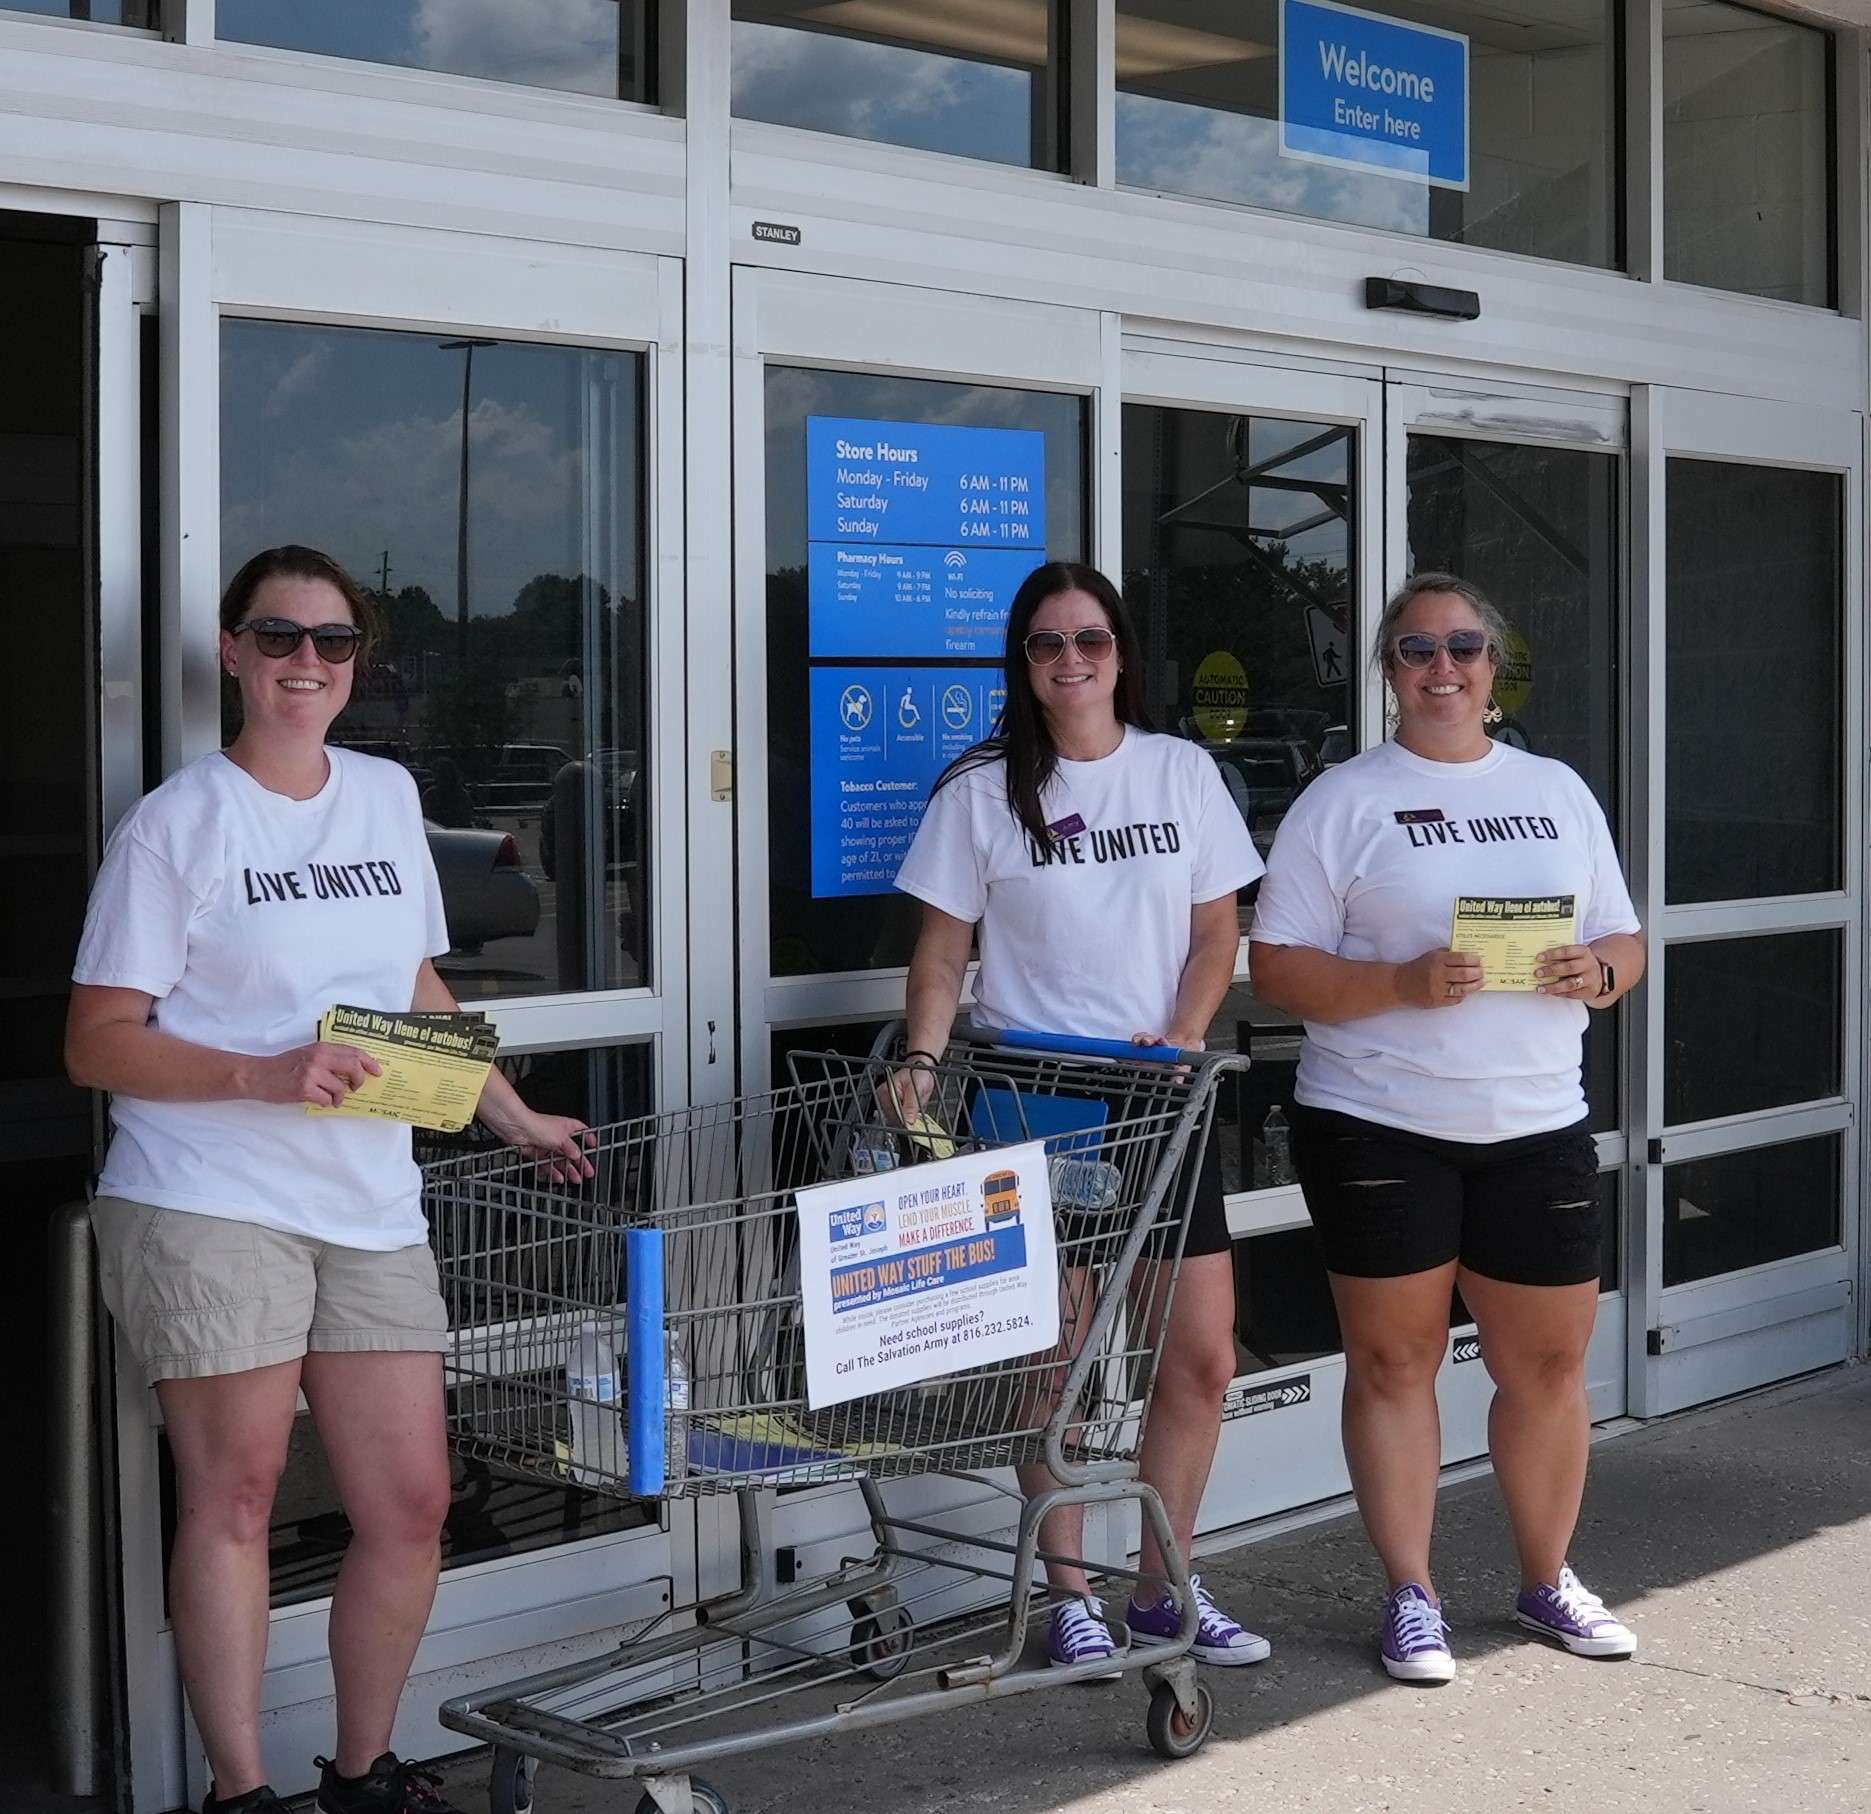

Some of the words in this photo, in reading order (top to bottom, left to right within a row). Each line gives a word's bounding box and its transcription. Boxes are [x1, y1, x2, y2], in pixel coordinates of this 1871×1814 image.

[1320, 40, 1434, 102] Welcome
[1335, 98, 1380, 130] Enter
[1385, 108, 1420, 140] here
[756, 226, 798, 241] STANLEY
[836, 440, 874, 460] Store
[876, 442, 918, 462] Hours
[837, 468, 882, 490] Monday
[894, 470, 928, 492] Friday
[960, 474, 968, 490] 6
[970, 475, 990, 490] AM
[1000, 476, 1008, 491] 11
[1010, 477, 1028, 492] PM
[837, 492, 888, 513] Saturday
[960, 498, 968, 514] 6
[970, 499, 990, 514] AM
[1000, 500, 1008, 514] 11
[1011, 500, 1029, 516] PM
[838, 517, 879, 538] Sunday
[960, 521, 968, 536] 6
[970, 522, 990, 536] AM
[1000, 523, 1008, 538] 11
[1011, 523, 1029, 538] PM
[837, 551, 878, 567] Pharmacy
[879, 553, 904, 565] Hours
[945, 588, 958, 599] No
[960, 588, 994, 602] soliciting
[945, 608, 970, 622] Kindly
[972, 609, 1000, 621] refrain
[945, 638, 976, 650] firearm
[1196, 688, 1246, 705] CAUTION
[840, 781, 874, 793] Tobacco
[840, 800, 887, 812] Customers
[890, 800, 907, 810] who
[841, 817, 854, 830] 40
[856, 817, 870, 828] will
[871, 818, 882, 828] be
[884, 816, 908, 828] asked
[910, 816, 919, 827] to
[1407, 821, 1465, 848] LIVE
[1468, 816, 1558, 844] UNITED
[841, 836, 876, 848] showing
[878, 836, 906, 847] proper
[1090, 822, 1180, 864] UNITED
[841, 854, 856, 867] age
[858, 851, 868, 862] of
[883, 853, 892, 861] or
[244, 867, 308, 906] LIVE
[308, 861, 402, 900] UNITED
[842, 868, 884, 884] permitted
[886, 868, 896, 880] to
[1460, 900, 1486, 912] United
[1488, 900, 1504, 916] Way
[336, 1008, 370, 1031] United
[372, 1015, 394, 1036] Way
[394, 1020, 418, 1038] llene
[420, 1026, 432, 1042] el
[430, 1030, 474, 1050] autobus!
[898, 1192, 918, 1210] OPEN
[920, 1188, 940, 1205] YOUR
[942, 1182, 968, 1200] HEART.
[830, 1208, 862, 1227] United
[898, 1212, 918, 1230] LEND
[920, 1207, 940, 1224] YOUR
[842, 1222, 863, 1237] Way
[898, 1230, 920, 1248] MAKE
[922, 1228, 928, 1241] A
[832, 1269, 876, 1298] UNITED
[878, 1260, 905, 1286] WAY
[908, 1254, 942, 1279] STUFF
[944, 1246, 966, 1271] THE
[968, 1238, 996, 1265] BUS!
[834, 1294, 872, 1312] presented
[872, 1290, 882, 1302] by
[882, 1282, 910, 1298] Mosaic
[910, 1279, 926, 1291] Life
[926, 1276, 944, 1287] Care
[880, 1332, 904, 1346] Need
[906, 1324, 938, 1341] school
[940, 1310, 985, 1333] supplies?
[836, 1360, 854, 1374] Call
[857, 1356, 875, 1369] The
[878, 1342, 921, 1362] Salvation
[924, 1336, 949, 1352] Army
[952, 1334, 960, 1344] at
[963, 1315, 1034, 1342] 816.232.5824.
